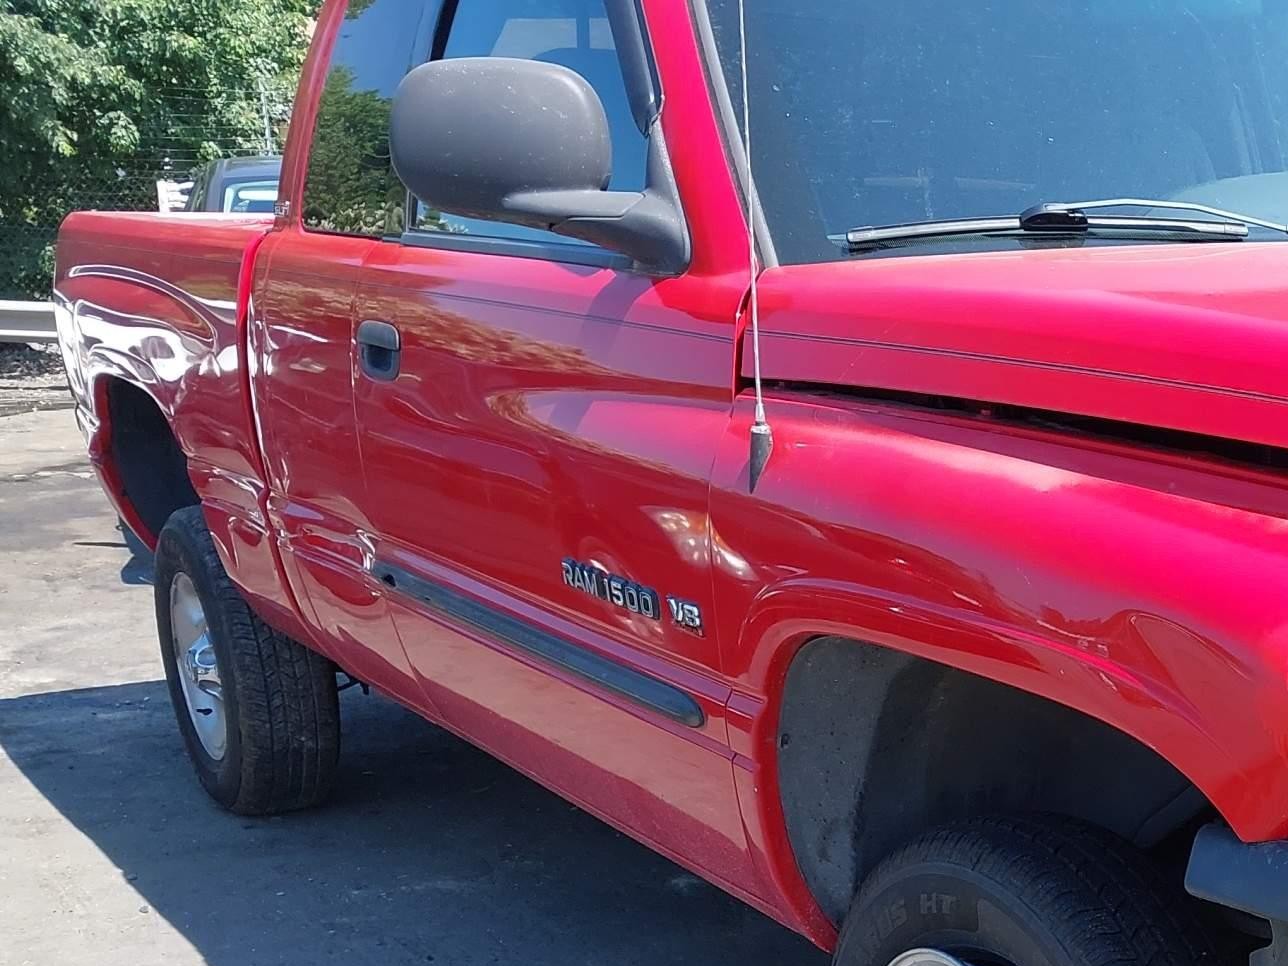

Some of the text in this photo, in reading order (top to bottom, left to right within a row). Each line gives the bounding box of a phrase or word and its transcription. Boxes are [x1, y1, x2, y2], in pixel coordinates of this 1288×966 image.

[561, 557, 702, 628] RAM 1500 V8
